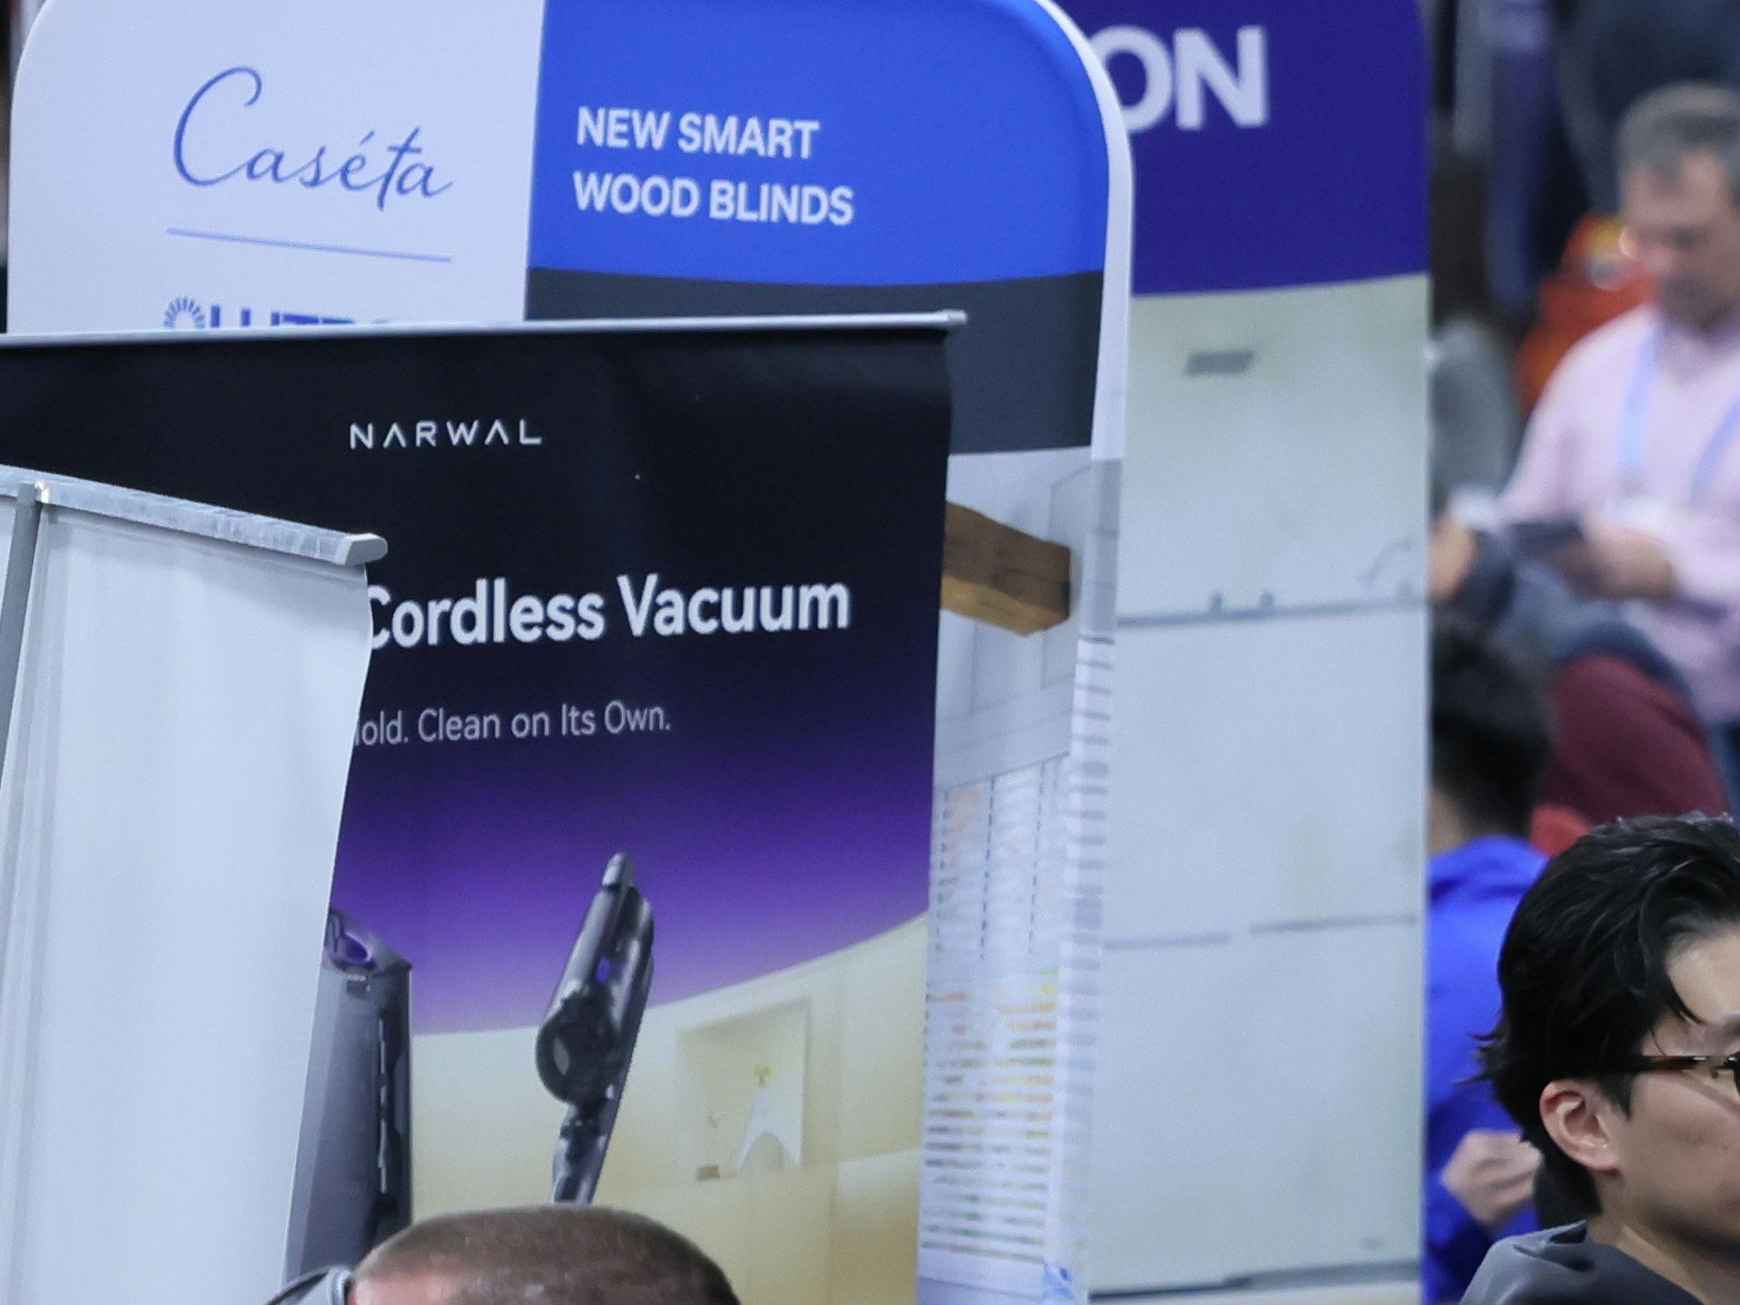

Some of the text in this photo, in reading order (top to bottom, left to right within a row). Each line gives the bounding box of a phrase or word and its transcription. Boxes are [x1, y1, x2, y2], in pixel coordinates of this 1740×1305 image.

[174, 66, 453, 212] Caséta
[576, 106, 820, 159] NEW SMART
[573, 170, 855, 226] WOOD BLINDS
[349, 418, 543, 450] NARWAL
[616, 573, 851, 638] Vacuum
[418, 706, 502, 743] Clean
[510, 710, 551, 739] on
[560, 702, 596, 737] Its
[604, 699, 672, 736] Own.
